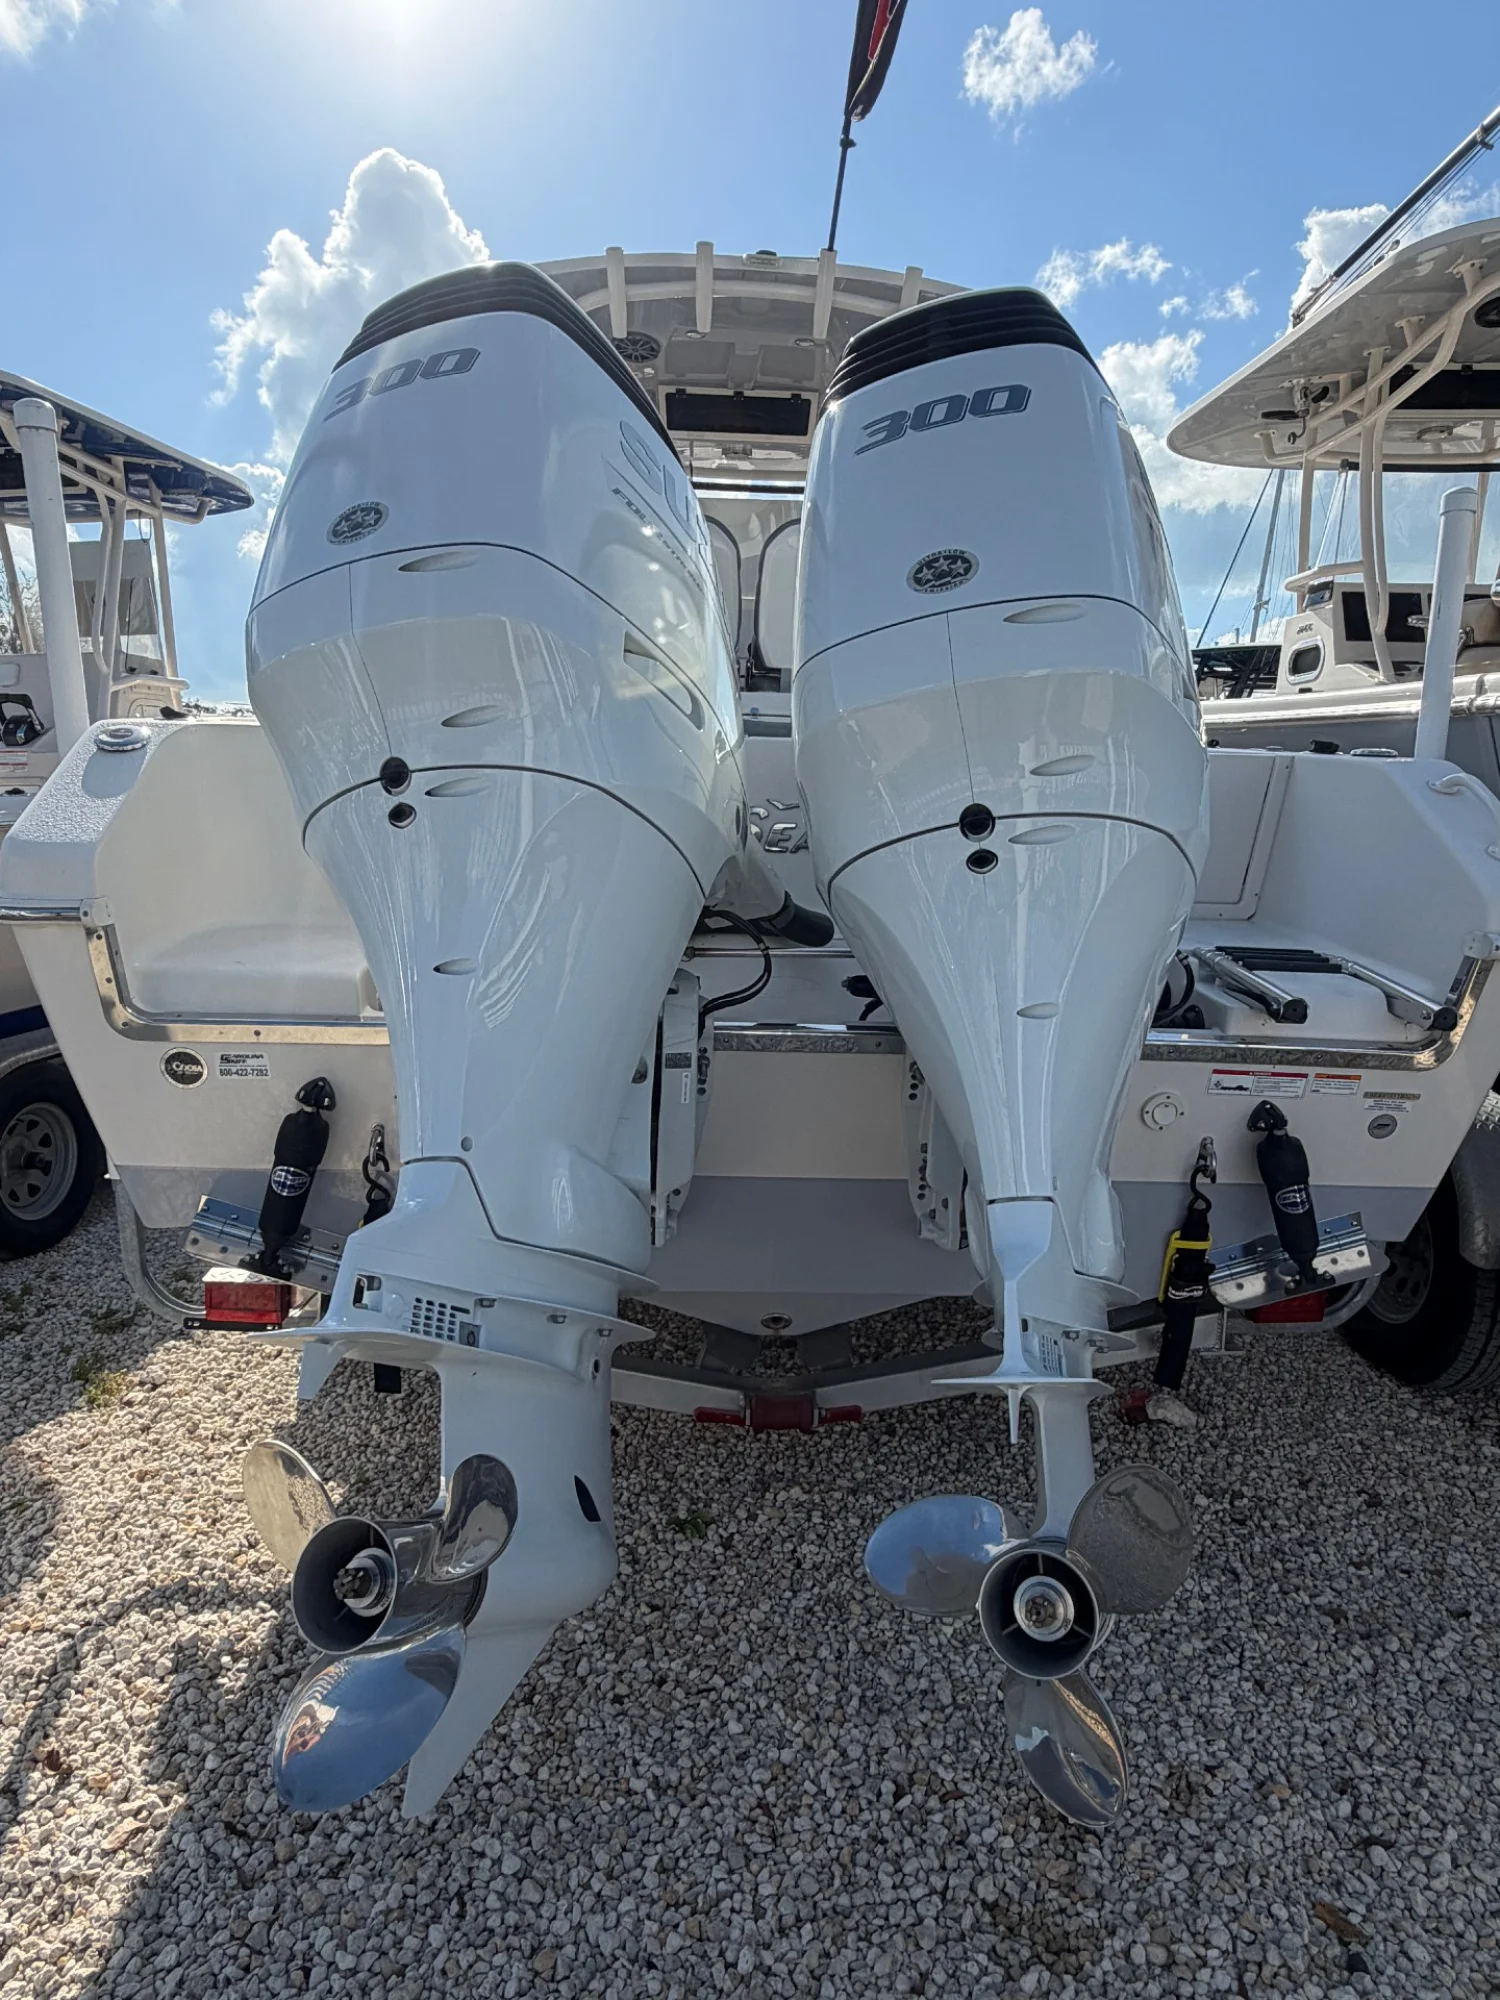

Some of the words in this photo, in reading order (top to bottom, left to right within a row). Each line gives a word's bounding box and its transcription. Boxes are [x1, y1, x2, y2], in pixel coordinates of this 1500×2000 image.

[323, 348, 481, 422] 300
[853, 384, 1032, 456] 300
[219, 1068, 270, 1077] 800-422-7282
